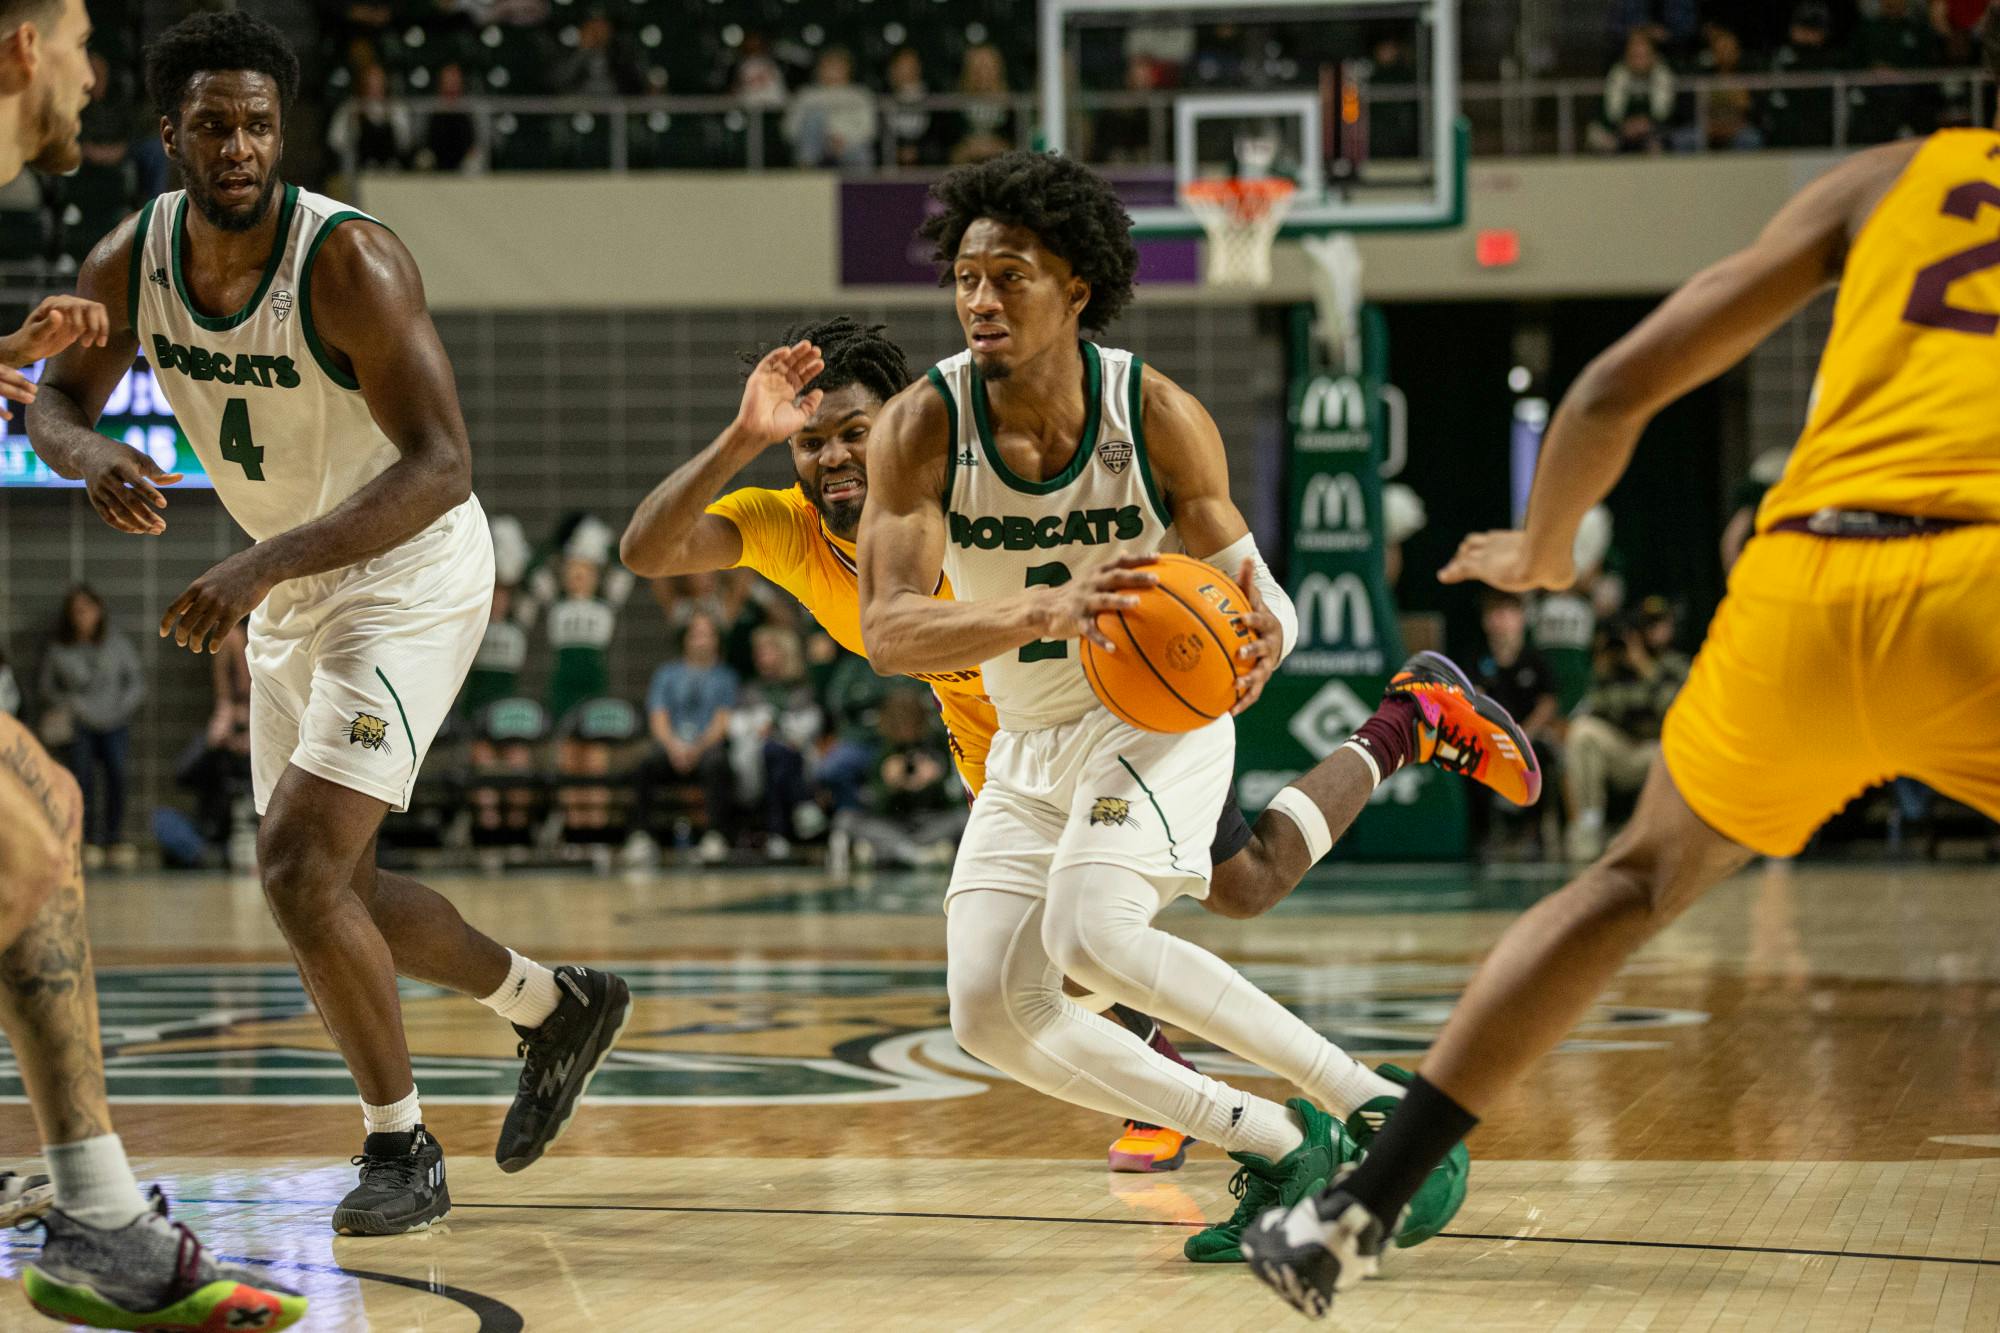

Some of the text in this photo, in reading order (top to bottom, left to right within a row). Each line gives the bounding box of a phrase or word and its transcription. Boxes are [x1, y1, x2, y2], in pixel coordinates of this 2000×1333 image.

[152, 334, 301, 388] BOBCATS
[219, 398, 265, 481] 4
[1101, 449, 1133, 461] MAC
[950, 505, 1144, 550] BOBCATS
